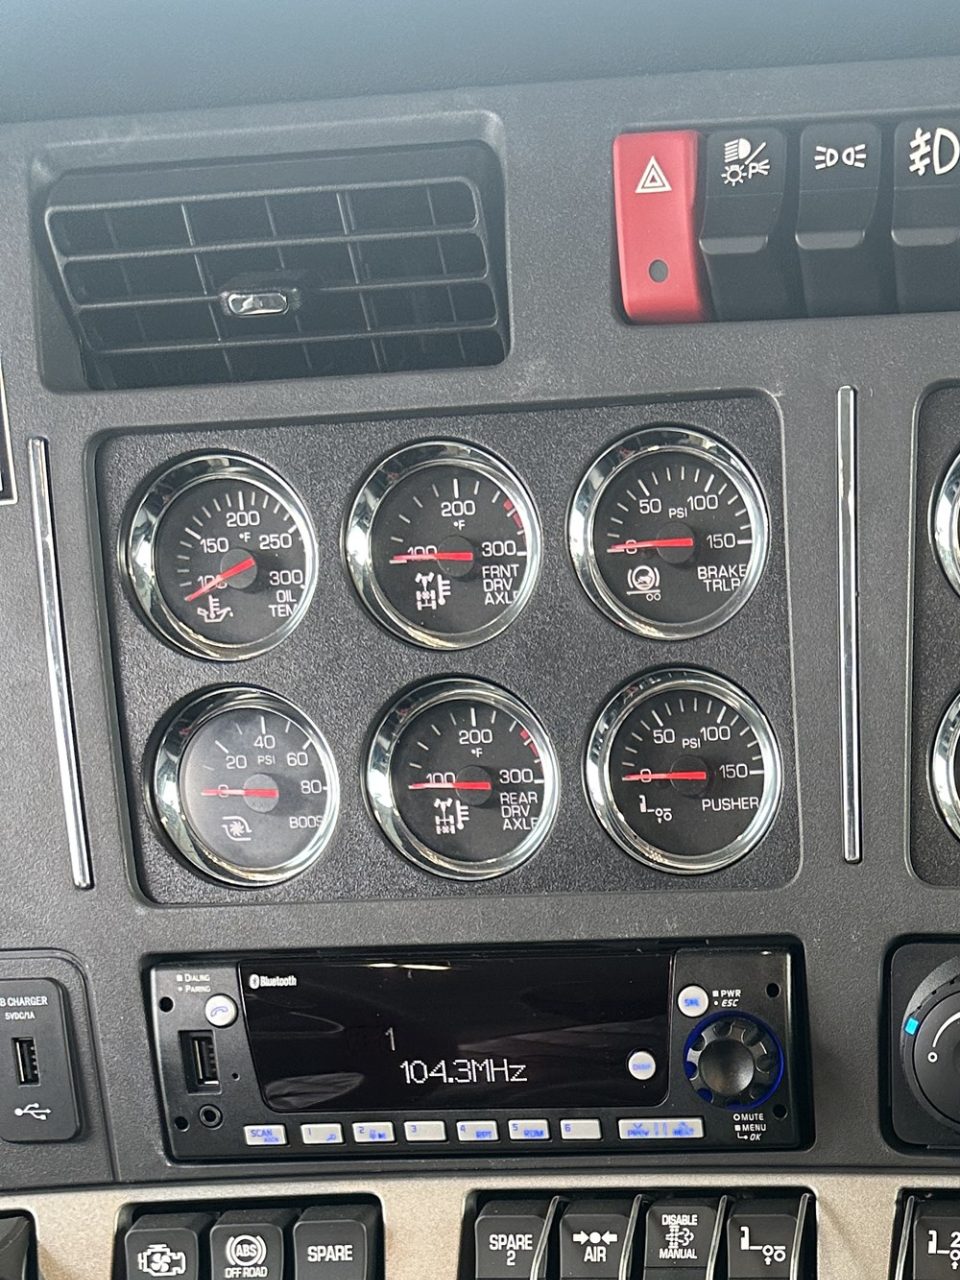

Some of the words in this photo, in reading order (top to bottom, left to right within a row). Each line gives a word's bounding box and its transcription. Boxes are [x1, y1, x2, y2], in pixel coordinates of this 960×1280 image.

[441, 500, 475, 517] 200
[639, 499, 661, 514] 50
[687, 495, 718, 511] 100
[226, 510, 260, 526] 200
[669, 508, 687, 518] PSI
[199, 537, 229, 553] 150
[259, 533, 292, 549] 250
[706, 533, 735, 548] 150
[482, 541, 516, 557] 300
[269, 570, 303, 586] 300
[482, 564, 519, 578] FRNT
[697, 565, 748, 580] BRAKE
[483, 579, 512, 592] DRV
[704, 579, 740, 592] TRLR
[276, 590, 297, 602] OIL
[459, 729, 493, 744] 200
[653, 729, 675, 744] 50
[700, 726, 731, 741] 100
[254, 735, 275, 749] 40
[682, 737, 701, 749] PSI
[226, 755, 247, 769] 20
[258, 755, 275, 765] PSI
[287, 752, 308, 766] 60
[500, 769, 533, 784] 300
[719, 763, 748, 779] 150
[301, 780, 322, 794] 80
[500, 792, 538, 804] REAR
[702, 797, 759, 812] PUSHER
[501, 806, 530, 817] DRV
[260, 976, 297, 987] Bluetooth
[721, 990, 741, 998] PWR
[7, 996, 48, 1007] CHARGER
[721, 999, 739, 1007] ESC
[385, 1027, 395, 1051] 1
[400, 1058, 528, 1084] 104.3MHz
[741, 1113, 764, 1121] MUTE
[742, 1124, 766, 1132] MENU
[749, 1133, 761, 1141] OK
[662, 1214, 698, 1226] DISABLE
[489, 1234, 533, 1250] SPARE
[236, 1244, 257, 1256] ABS
[308, 1245, 353, 1262] SPARE
[584, 1246, 607, 1262] AIR
[659, 1248, 698, 1260] MANUAL
[506, 1251, 516, 1266] 2
[224, 1267, 242, 1279] OFF
[243, 1266, 268, 1278] ROAD
